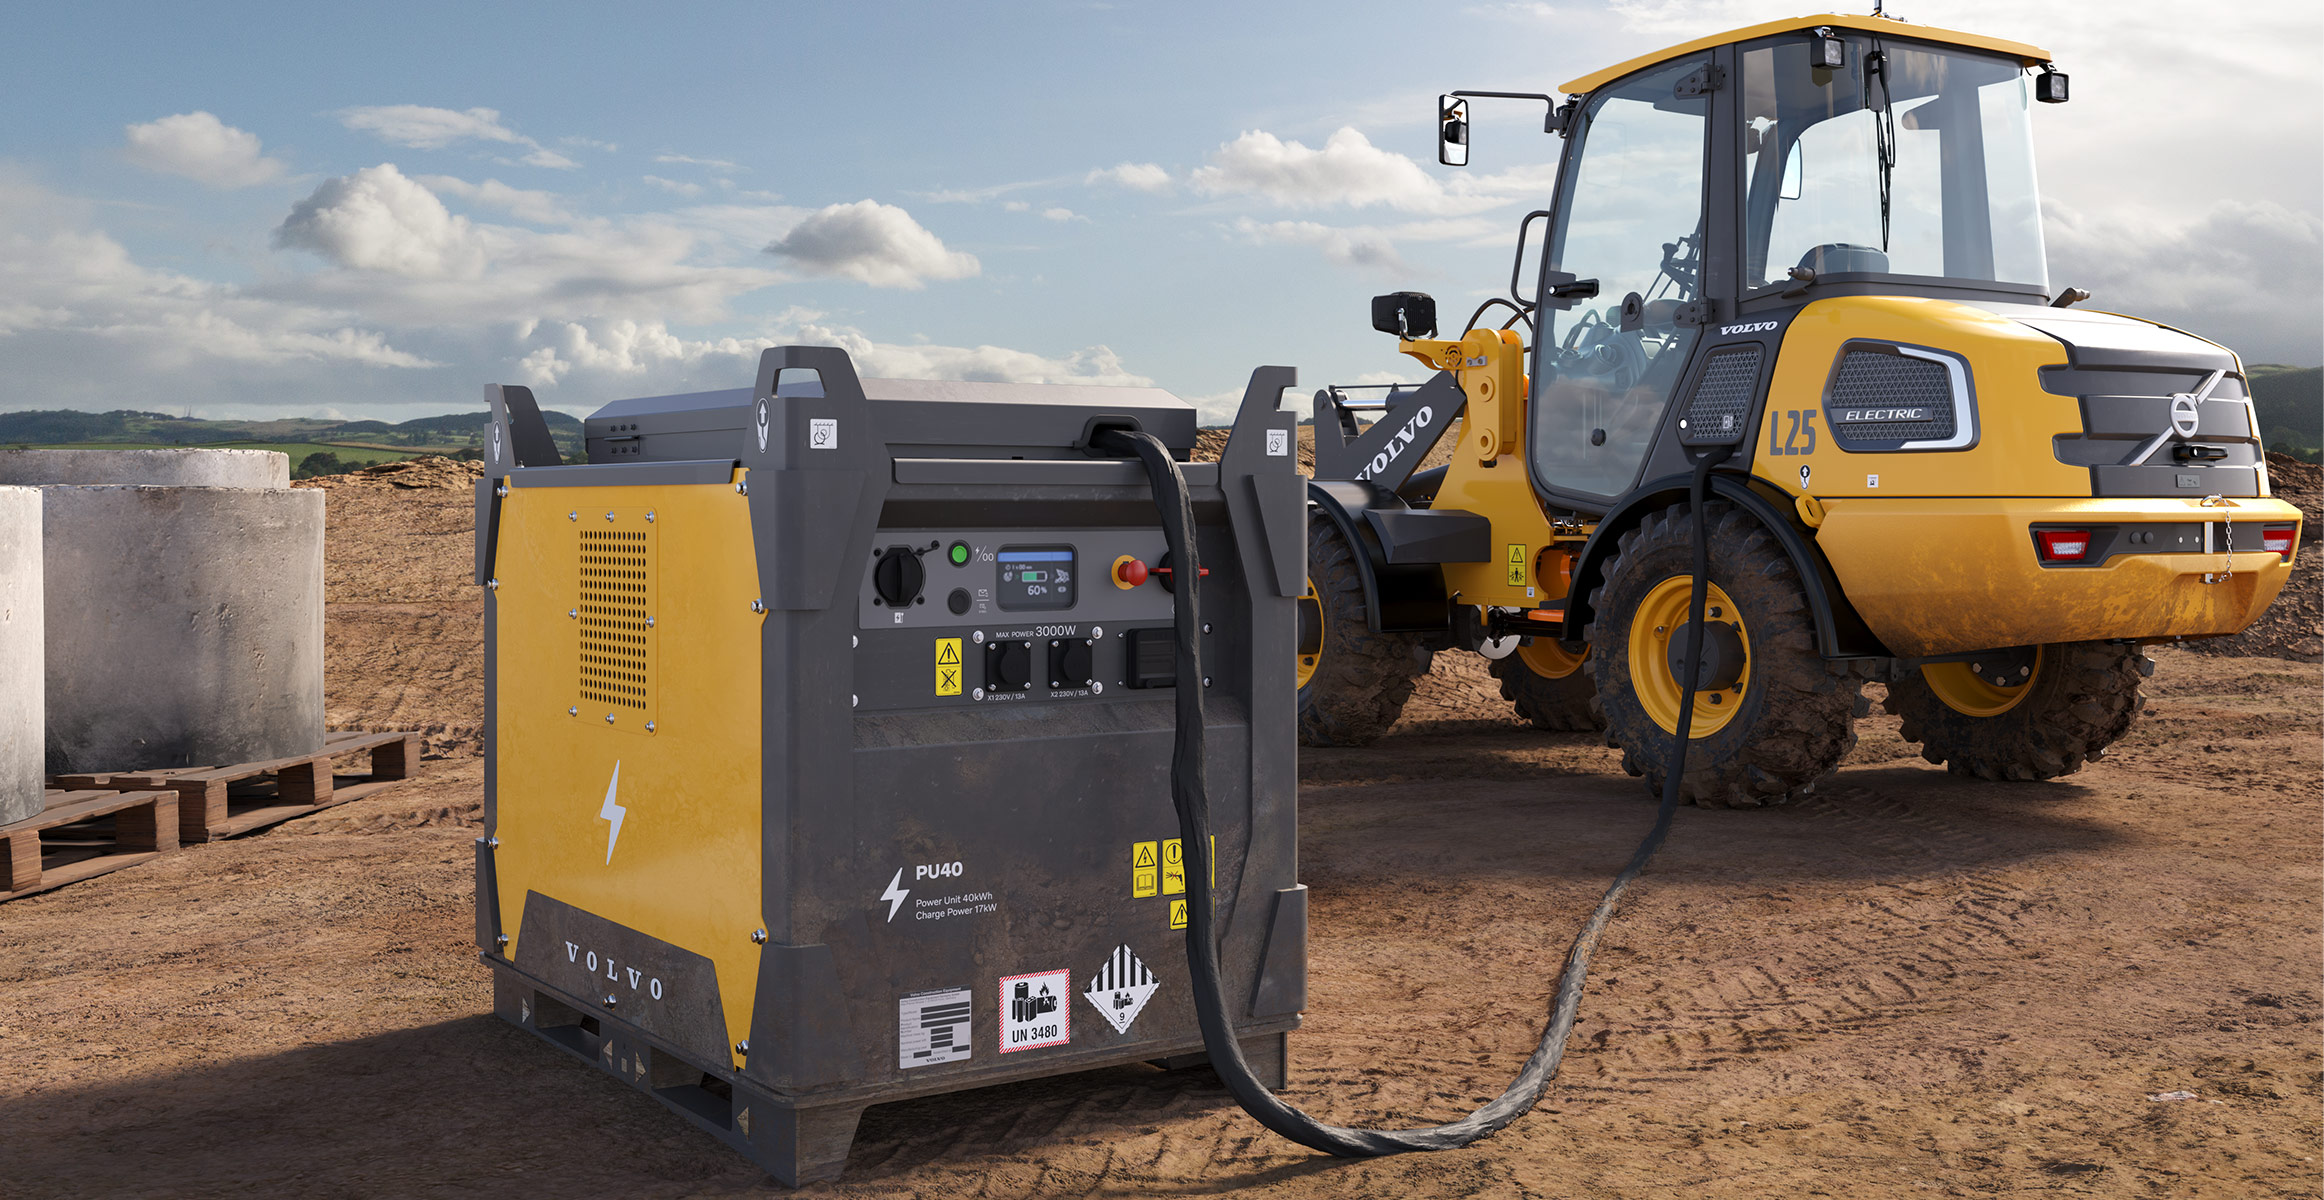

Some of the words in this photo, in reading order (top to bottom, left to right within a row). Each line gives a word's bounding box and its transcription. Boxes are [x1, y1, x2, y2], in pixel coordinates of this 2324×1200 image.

[1720, 320, 1778, 336] VOLVO
[1845, 408, 1923, 421] ELECTRIC
[1769, 409, 1817, 456] L25
[1011, 630, 1034, 638] POWER
[1035, 625, 1076, 637] 3000W
[916, 861, 963, 880] PU40
[916, 898, 942, 908] Power
[944, 895, 961, 905] Unit
[962, 892, 993, 902] 40kWh
[915, 909, 946, 920] Charge
[947, 906, 973, 916] Power
[974, 903, 998, 913] 17kW
[565, 940, 663, 1001] VOLVO
[1119, 1012, 1126, 1021] 9
[1012, 1028, 1028, 1043] UN
[1031, 1024, 1058, 1040] 3480
